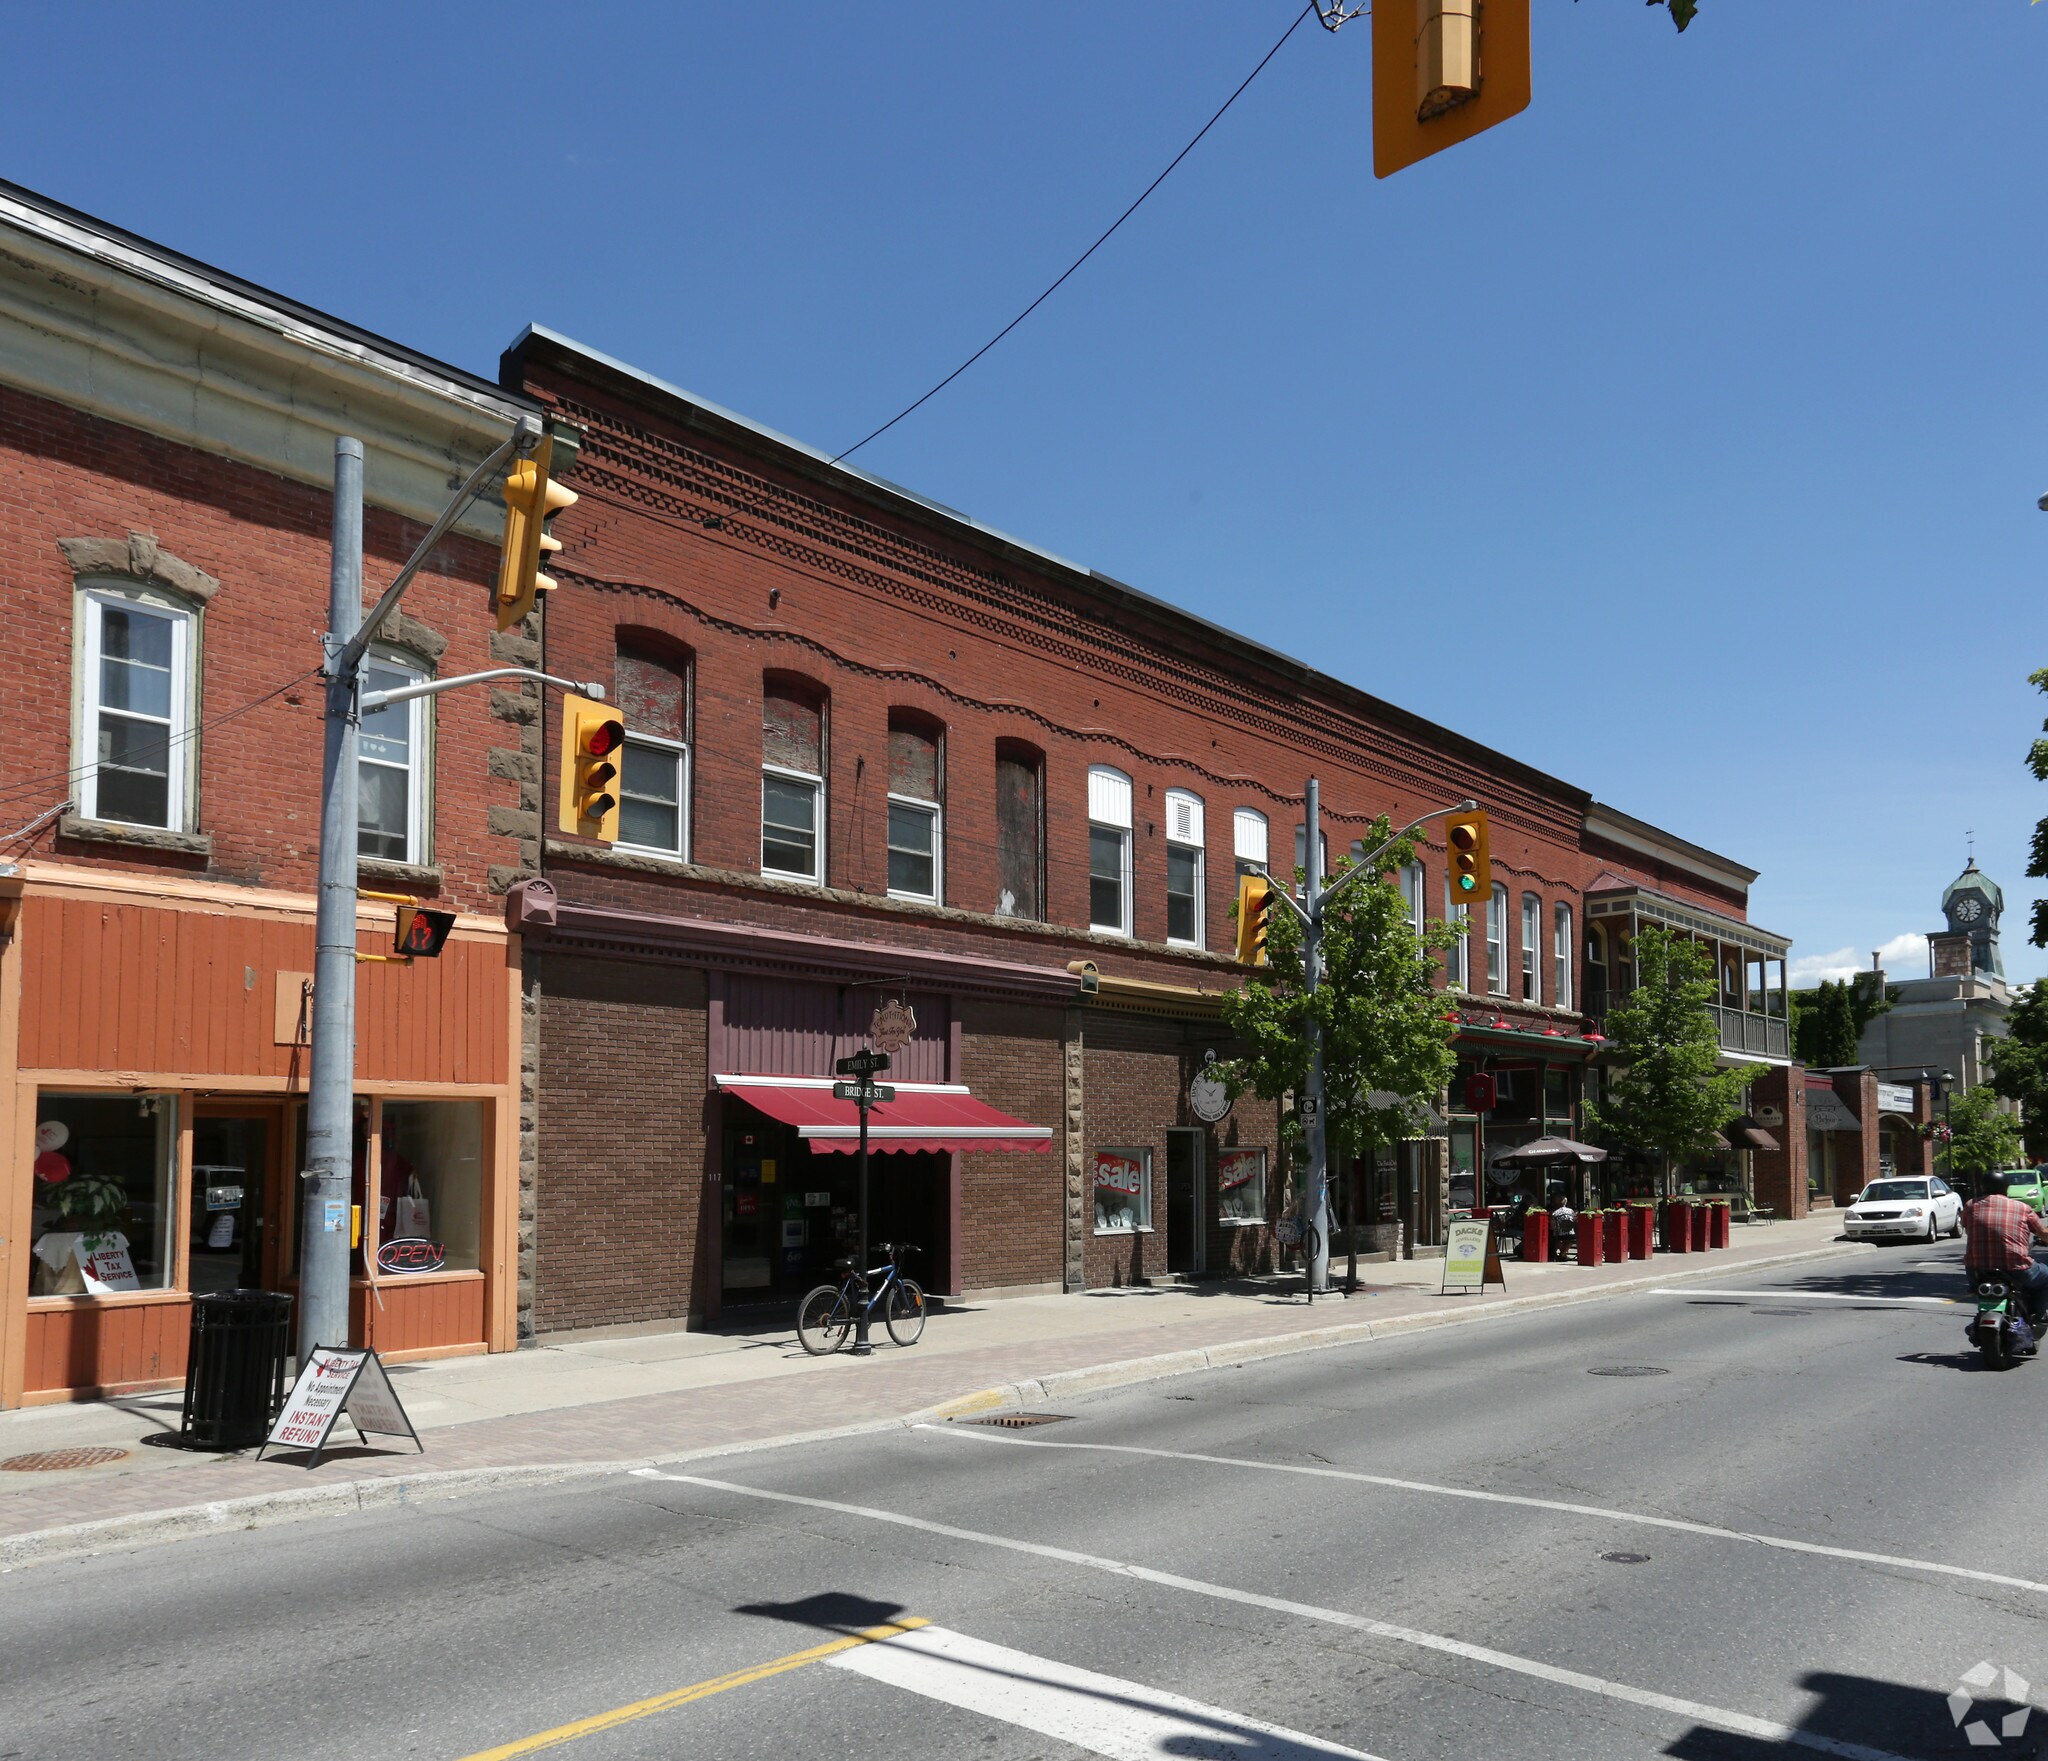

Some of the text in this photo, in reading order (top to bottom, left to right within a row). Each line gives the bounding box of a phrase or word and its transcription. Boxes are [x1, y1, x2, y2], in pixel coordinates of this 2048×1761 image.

[847, 1057, 879, 1070] EMILY ST.
[844, 1086, 884, 1098] BRIDGE ST.
[1223, 1153, 1257, 1186] sale
[709, 1173, 721, 1181] 117
[1099, 1162, 1140, 1193] sale
[1455, 1227, 1484, 1237] DACKS
[92, 1251, 125, 1261] LIBERTY
[380, 1244, 445, 1264] OPEN
[104, 1262, 121, 1271] TAX
[100, 1271, 133, 1281] SERVICE
[327, 1369, 350, 1379] SERVICE
[306, 1381, 346, 1395] No Appointment
[304, 1395, 331, 1410] Necessary
[288, 1411, 330, 1427] INSTANT
[279, 1427, 320, 1443] REFUND
